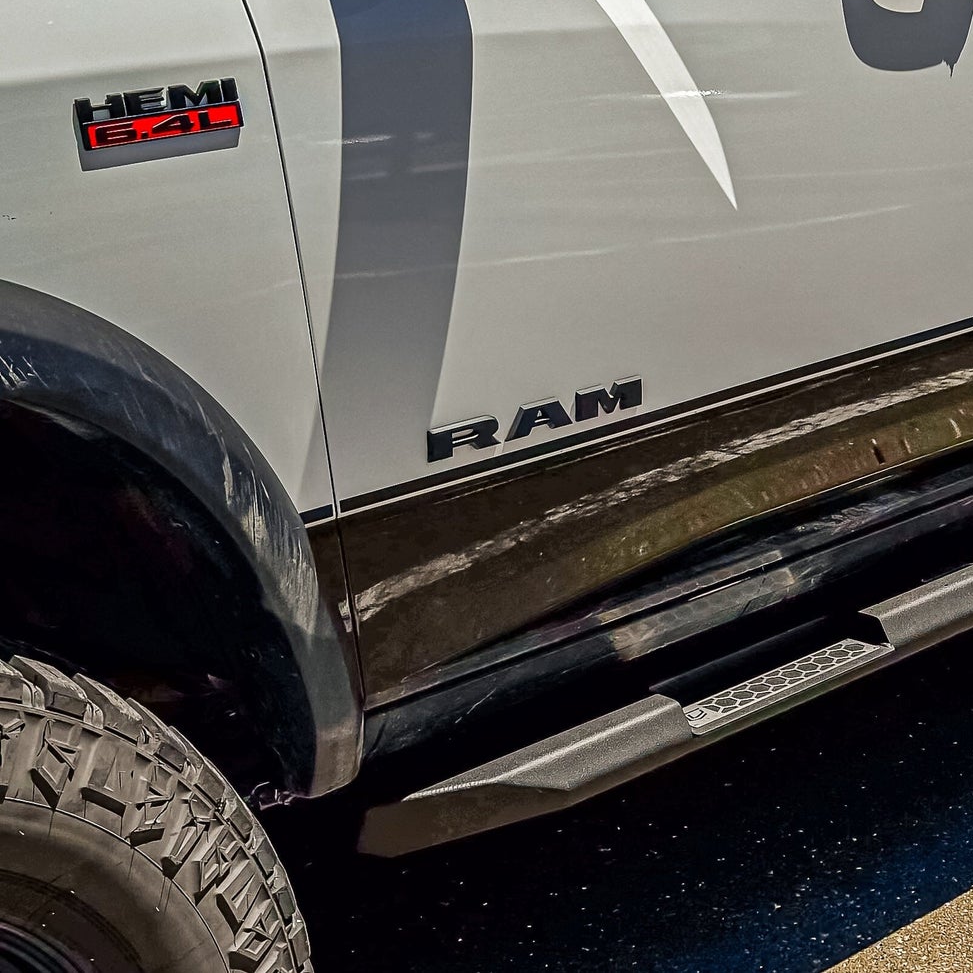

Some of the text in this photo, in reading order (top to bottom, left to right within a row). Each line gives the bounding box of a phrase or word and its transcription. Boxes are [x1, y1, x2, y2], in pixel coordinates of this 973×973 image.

[74, 78, 239, 123] HEMI
[95, 110, 232, 145] 6.4L
[427, 375, 643, 463] RAM
